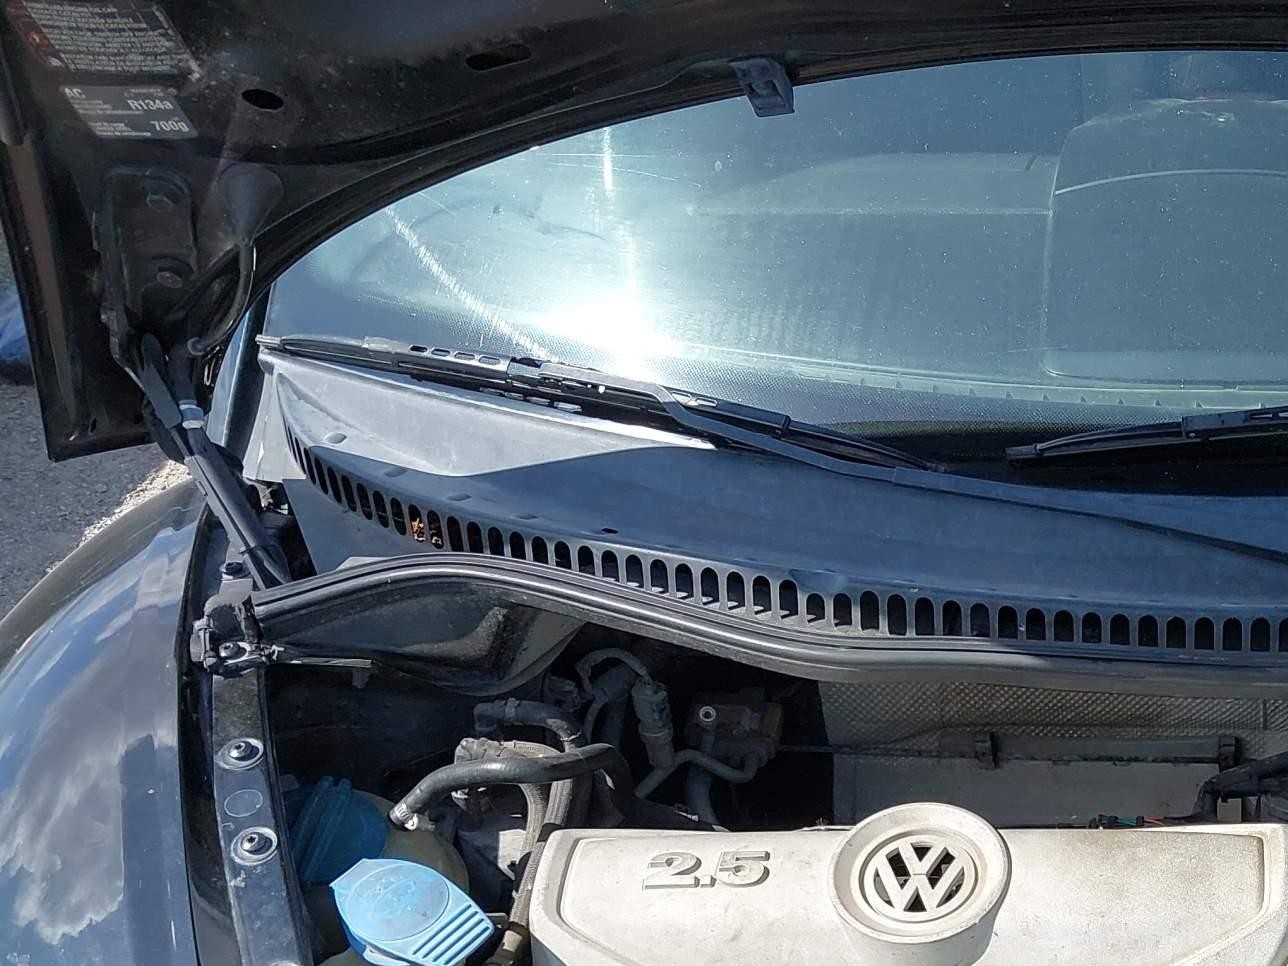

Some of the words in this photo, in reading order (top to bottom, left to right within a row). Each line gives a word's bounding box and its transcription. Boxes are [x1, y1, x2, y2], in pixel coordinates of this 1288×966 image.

[128, 99, 173, 110] R134a
[150, 121, 189, 132] 700g
[642, 850, 770, 889] 2.5
